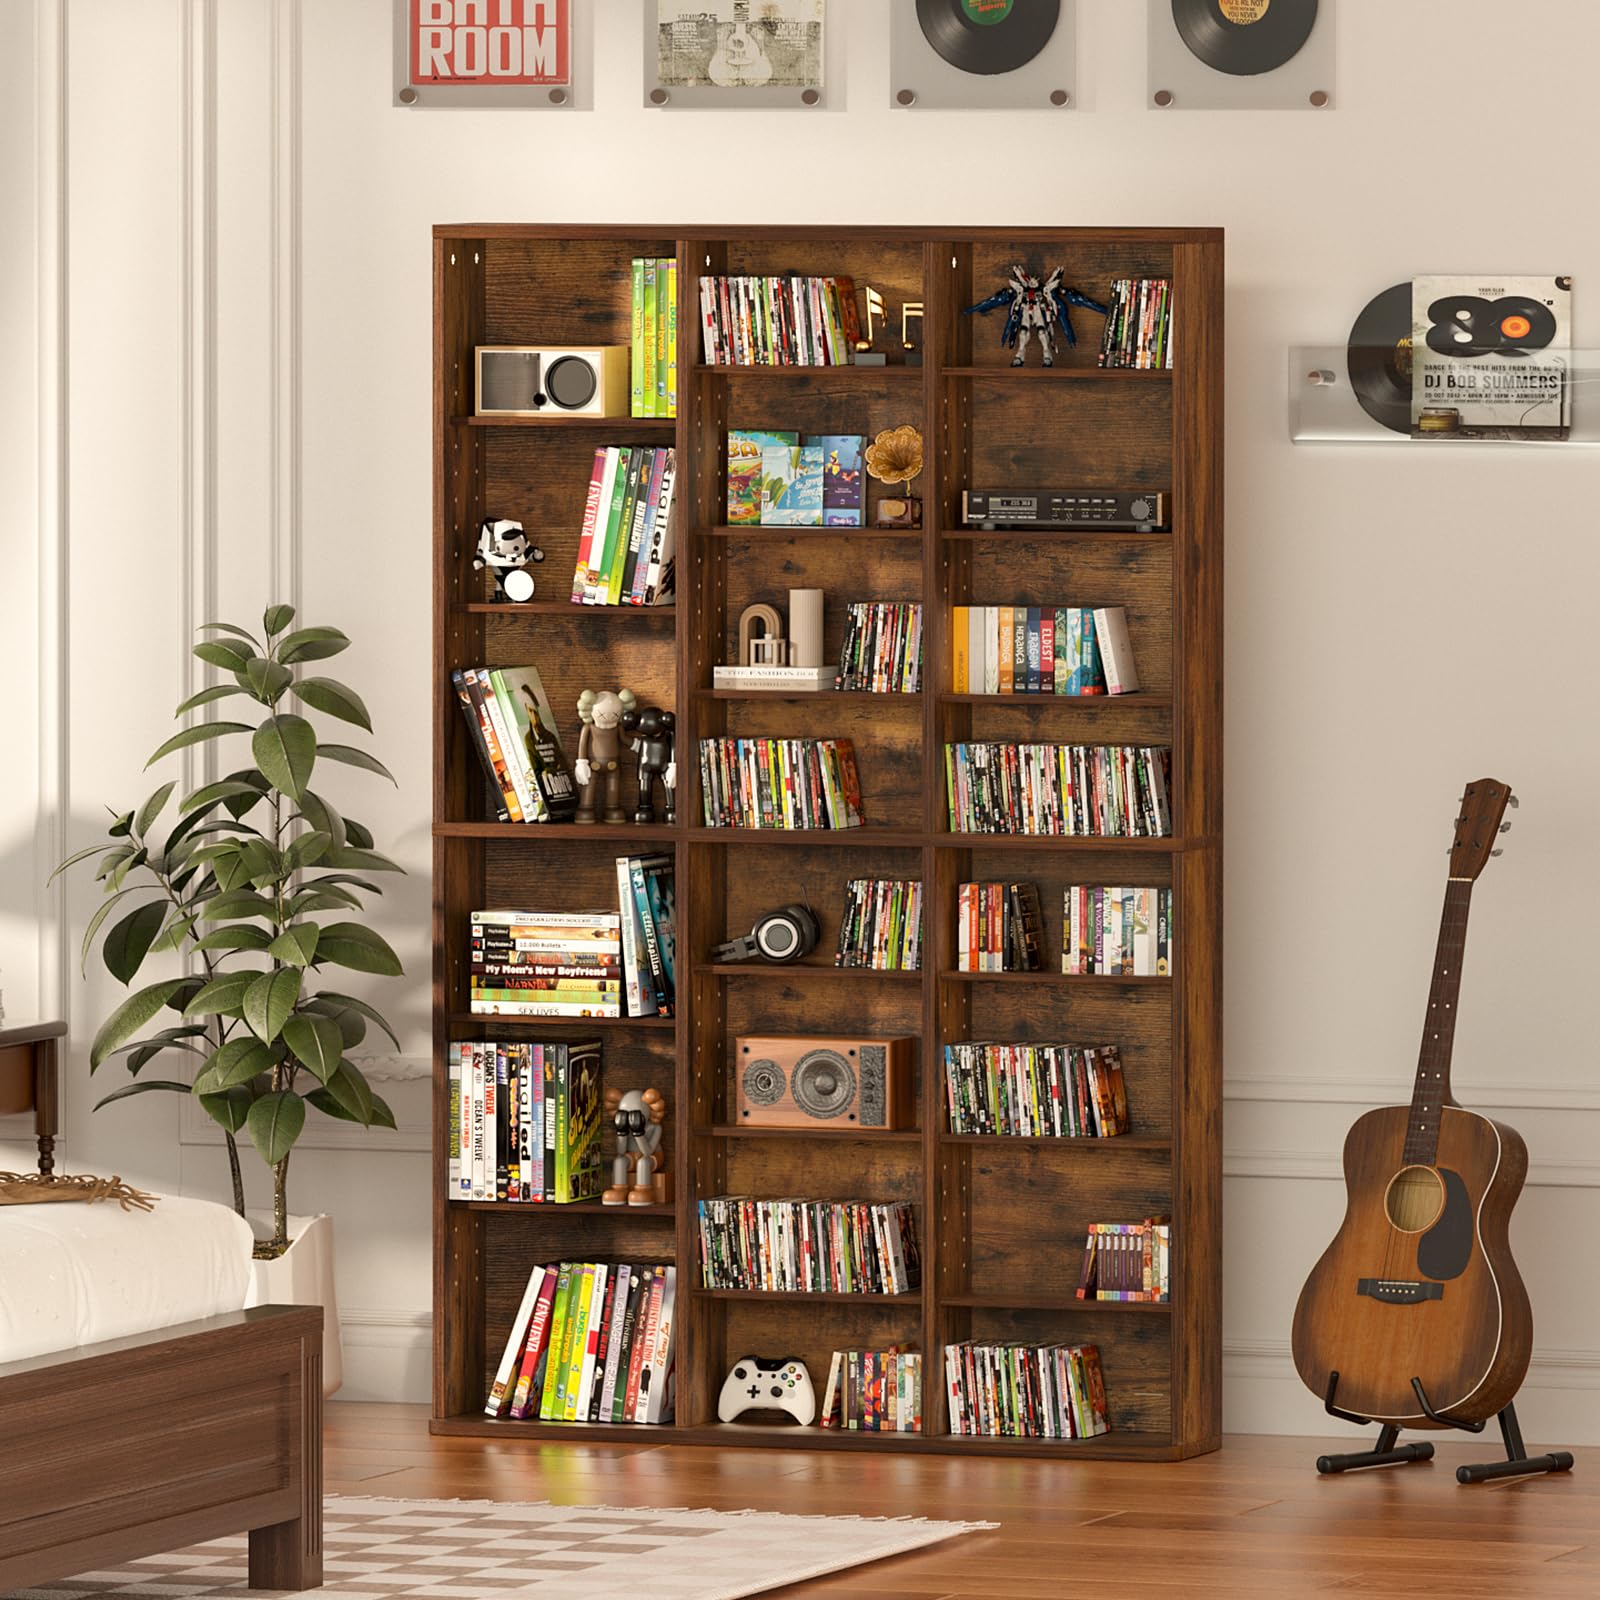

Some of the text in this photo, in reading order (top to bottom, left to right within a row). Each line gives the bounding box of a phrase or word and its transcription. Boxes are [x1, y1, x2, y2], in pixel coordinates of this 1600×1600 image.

[419, 27, 556, 76] ROOM
[1424, 375, 1558, 388] DJ BOB SUMMERS
[582, 480, 602, 536] CENICIENTA
[1042, 628, 1052, 662] ELDEST
[486, 965, 607, 977] My Mom's New Boyfriend
[647, 938, 660, 976] Papillon
[504, 978, 548, 990] NARNIA
[485, 1051, 495, 1115] OCEAN'S TWELVE
[474, 1100, 483, 1161] OCEAN'S TWELVE
[521, 1075, 530, 1161] nailed
[526, 1297, 551, 1352] CENICIENTA
[611, 1301, 626, 1344] CHANGE
[646, 1292, 663, 1336] CHRISTMAS
[598, 1334, 608, 1359] DEATH
[643, 1339, 655, 1361] CAROL
[605, 1361, 617, 1393] HEART
